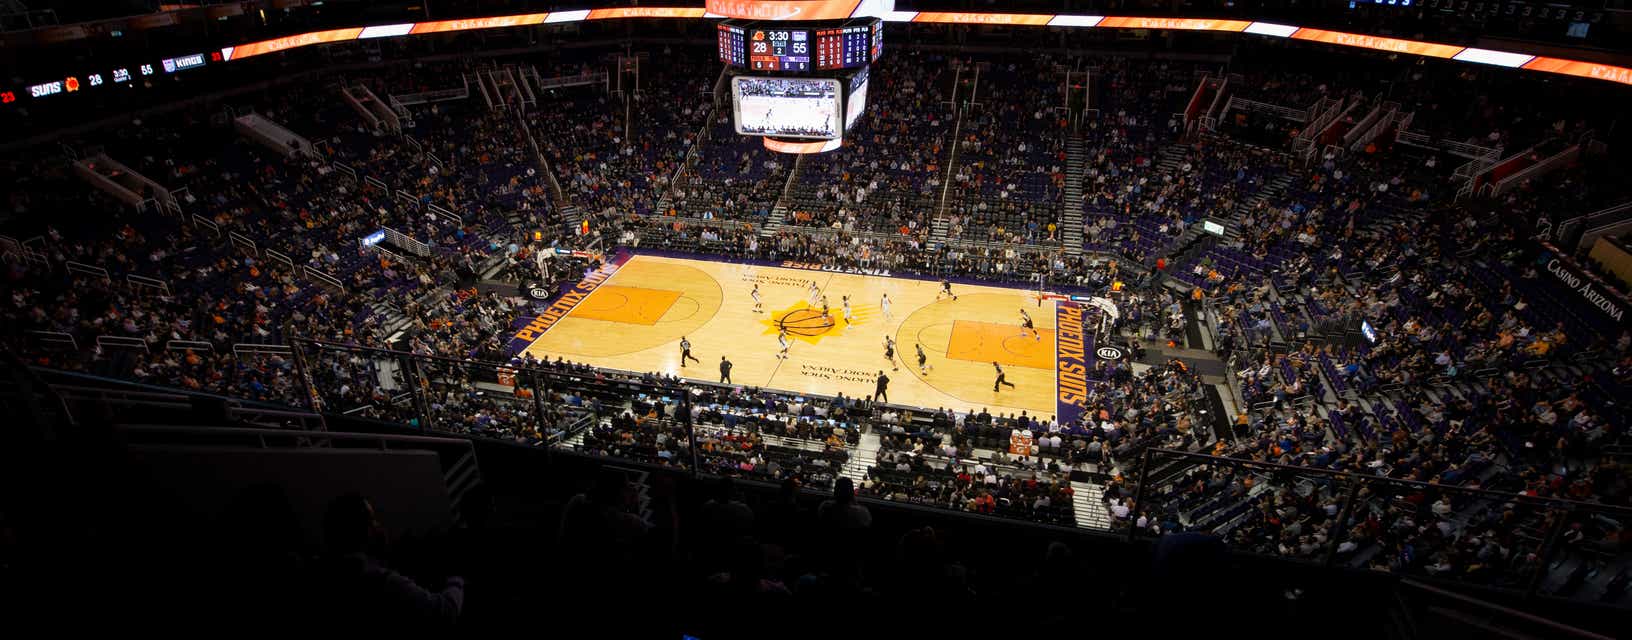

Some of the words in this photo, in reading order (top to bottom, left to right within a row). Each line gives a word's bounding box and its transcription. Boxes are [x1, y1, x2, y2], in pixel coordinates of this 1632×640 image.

[753, 42, 767, 53] 28
[792, 42, 807, 54] 55
[769, 31, 788, 41] 3:30
[88, 73, 103, 87] 28
[113, 68, 129, 78] 3:30
[140, 63, 154, 76] 55
[176, 56, 203, 68] KINGS
[514, 289, 588, 342] PHOENIX
[1058, 304, 1085, 363] PHOENIX
[1059, 360, 1087, 408] SUNS
